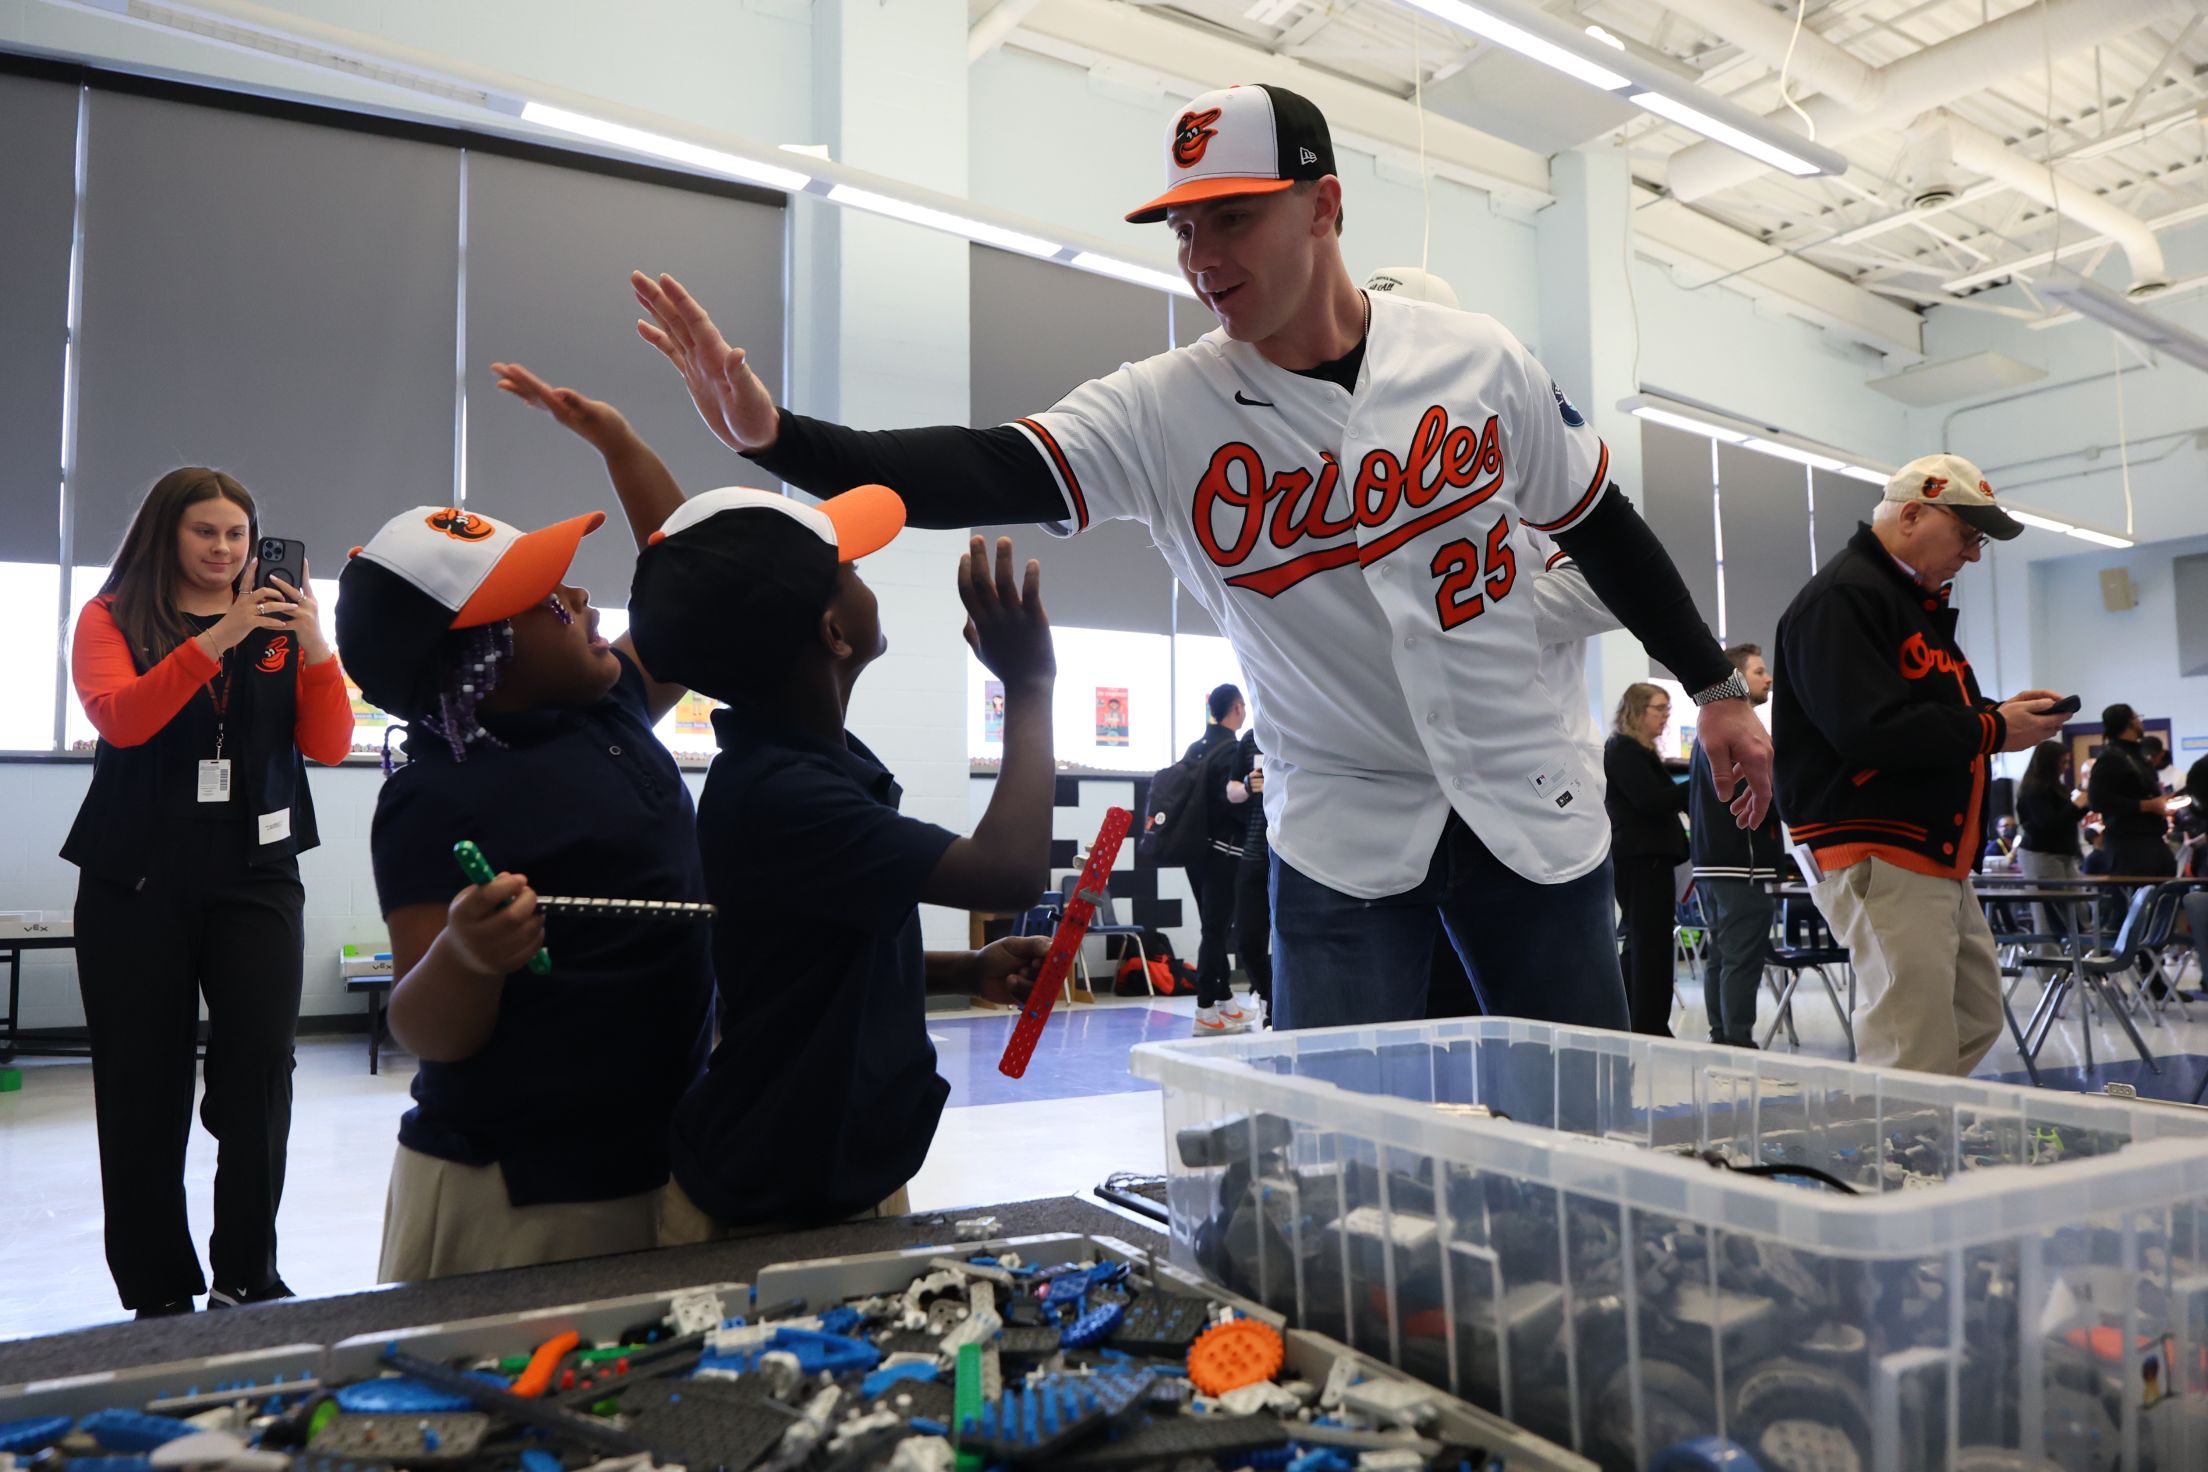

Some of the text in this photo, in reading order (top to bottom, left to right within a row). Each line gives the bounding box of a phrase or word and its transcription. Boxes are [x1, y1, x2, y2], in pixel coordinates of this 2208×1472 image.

[1192, 405, 1504, 568] Orioles
[1430, 514, 1517, 631] 25
[23, 924, 48, 932] VEX
